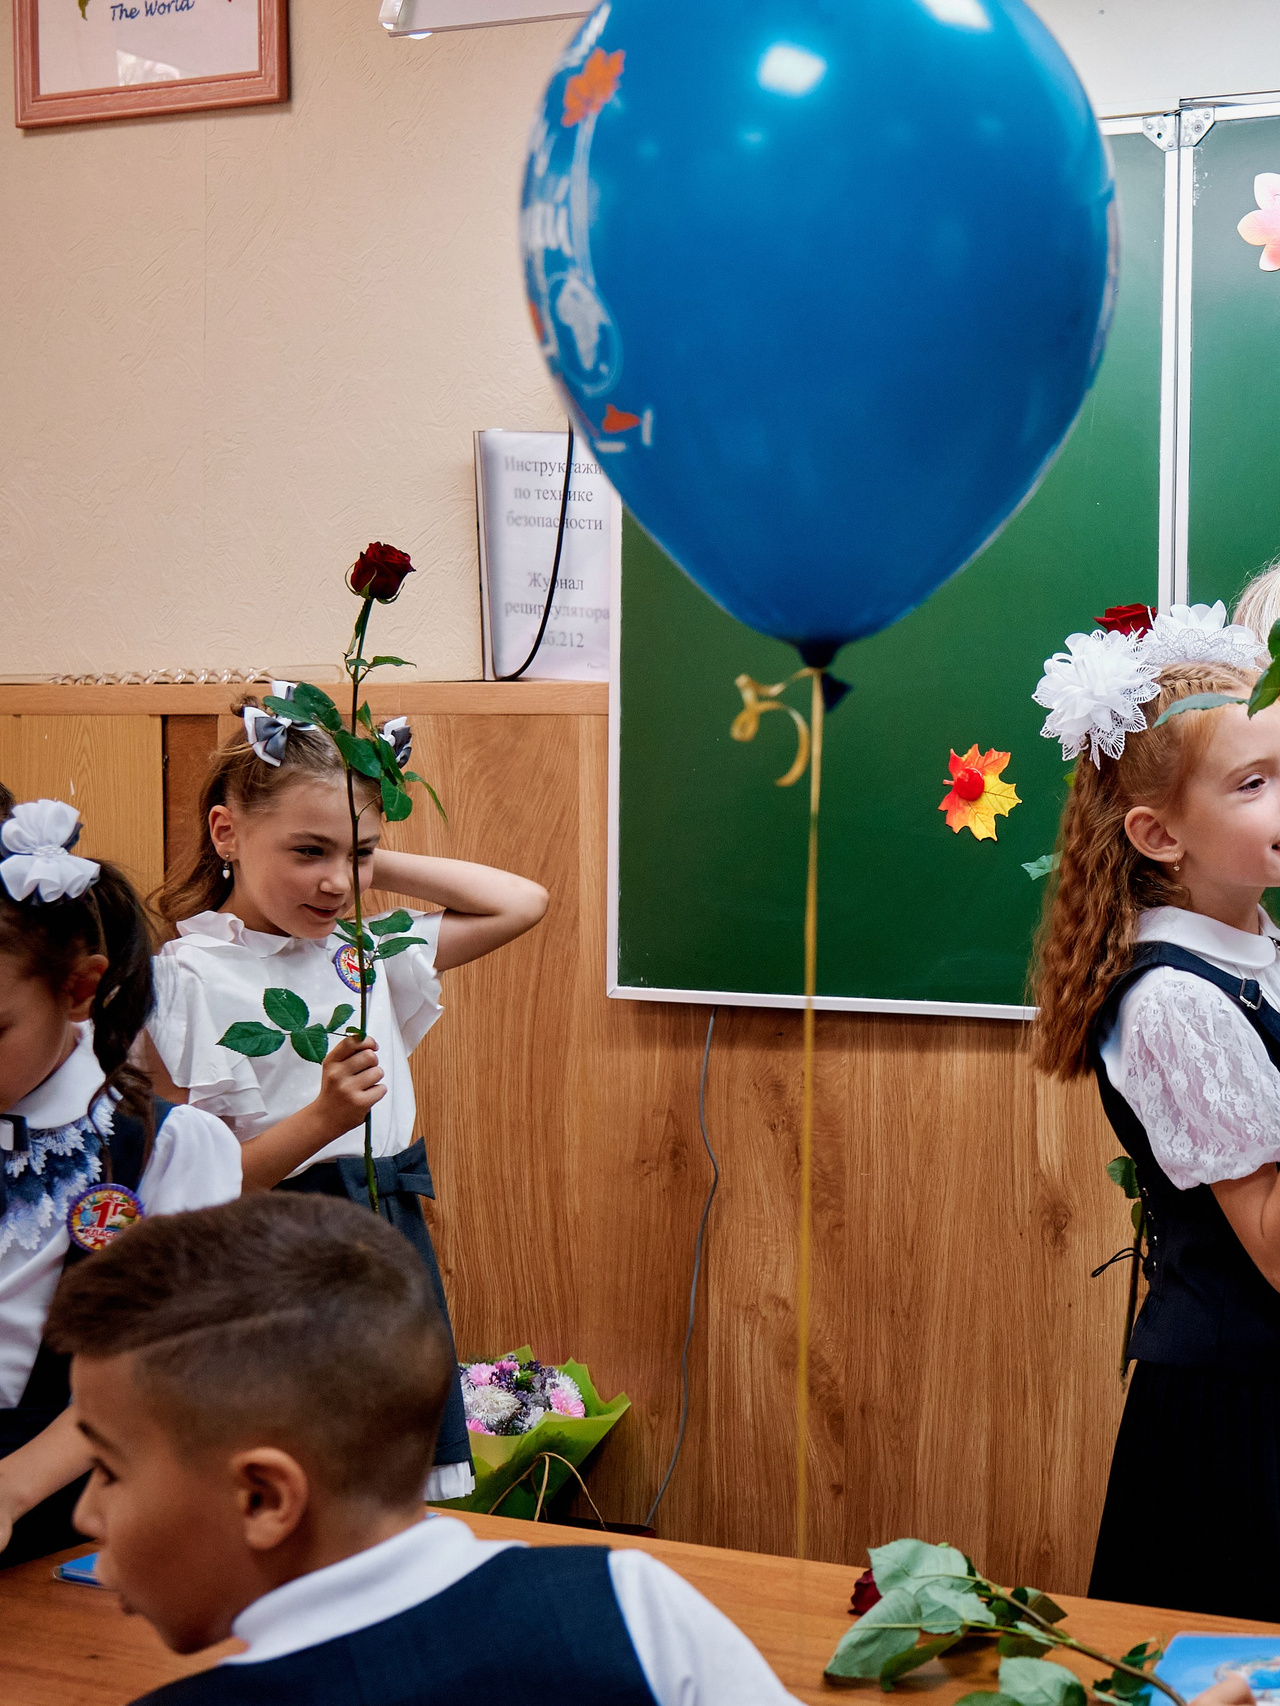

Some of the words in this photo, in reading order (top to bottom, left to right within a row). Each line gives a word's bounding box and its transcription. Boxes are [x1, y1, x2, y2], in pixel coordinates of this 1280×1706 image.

[110, 3, 140, 21] The
[144, 0, 195, 17] World
[504, 455, 602, 477] Инструкажи
[514, 487, 531, 499] по
